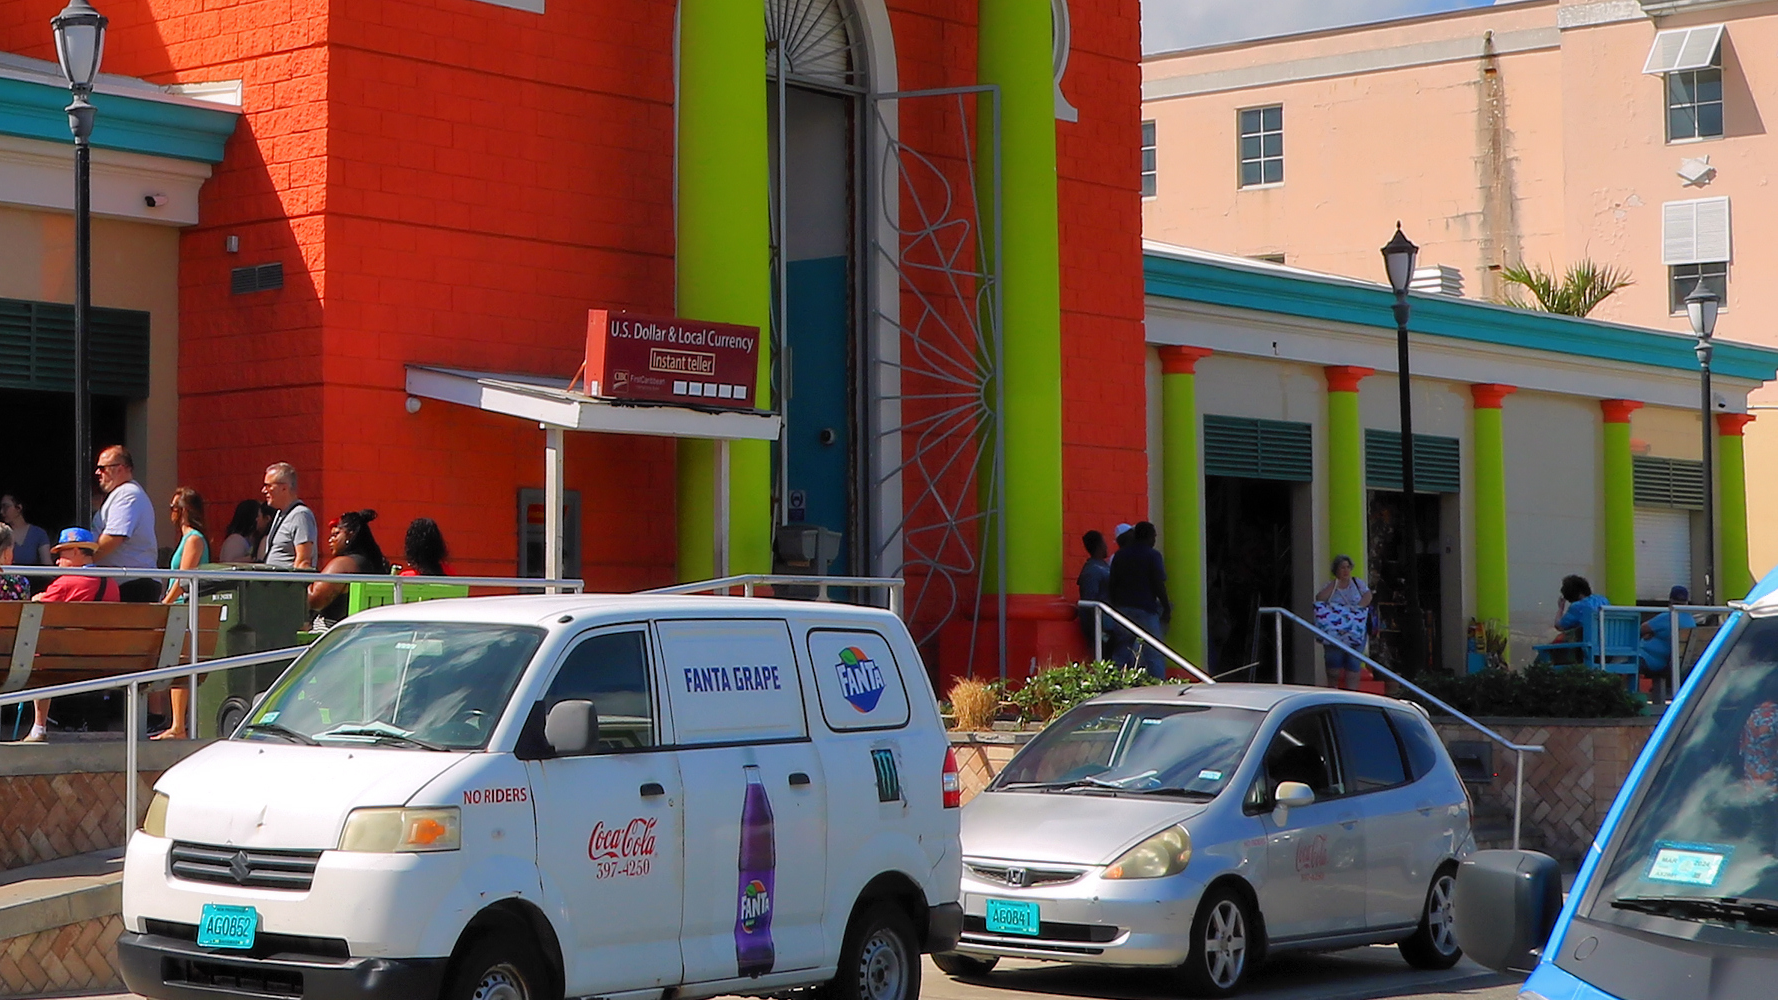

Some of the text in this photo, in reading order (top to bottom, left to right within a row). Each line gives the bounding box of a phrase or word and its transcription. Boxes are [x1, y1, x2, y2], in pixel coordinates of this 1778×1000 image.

[611, 320, 754, 354] U.S. Dollar & Local Currency
[652, 351, 713, 373] Instant teller
[684, 665, 781, 692] FANTA GRAPE
[836, 661, 884, 698] FANTA
[463, 787, 528, 805] NO RIDERS
[588, 816, 658, 860] Coca-Cola
[596, 859, 651, 880] 397-4250
[741, 892, 770, 920] FANTA
[992, 909, 1031, 926] AG0841
[206, 916, 251, 937] AG0852
